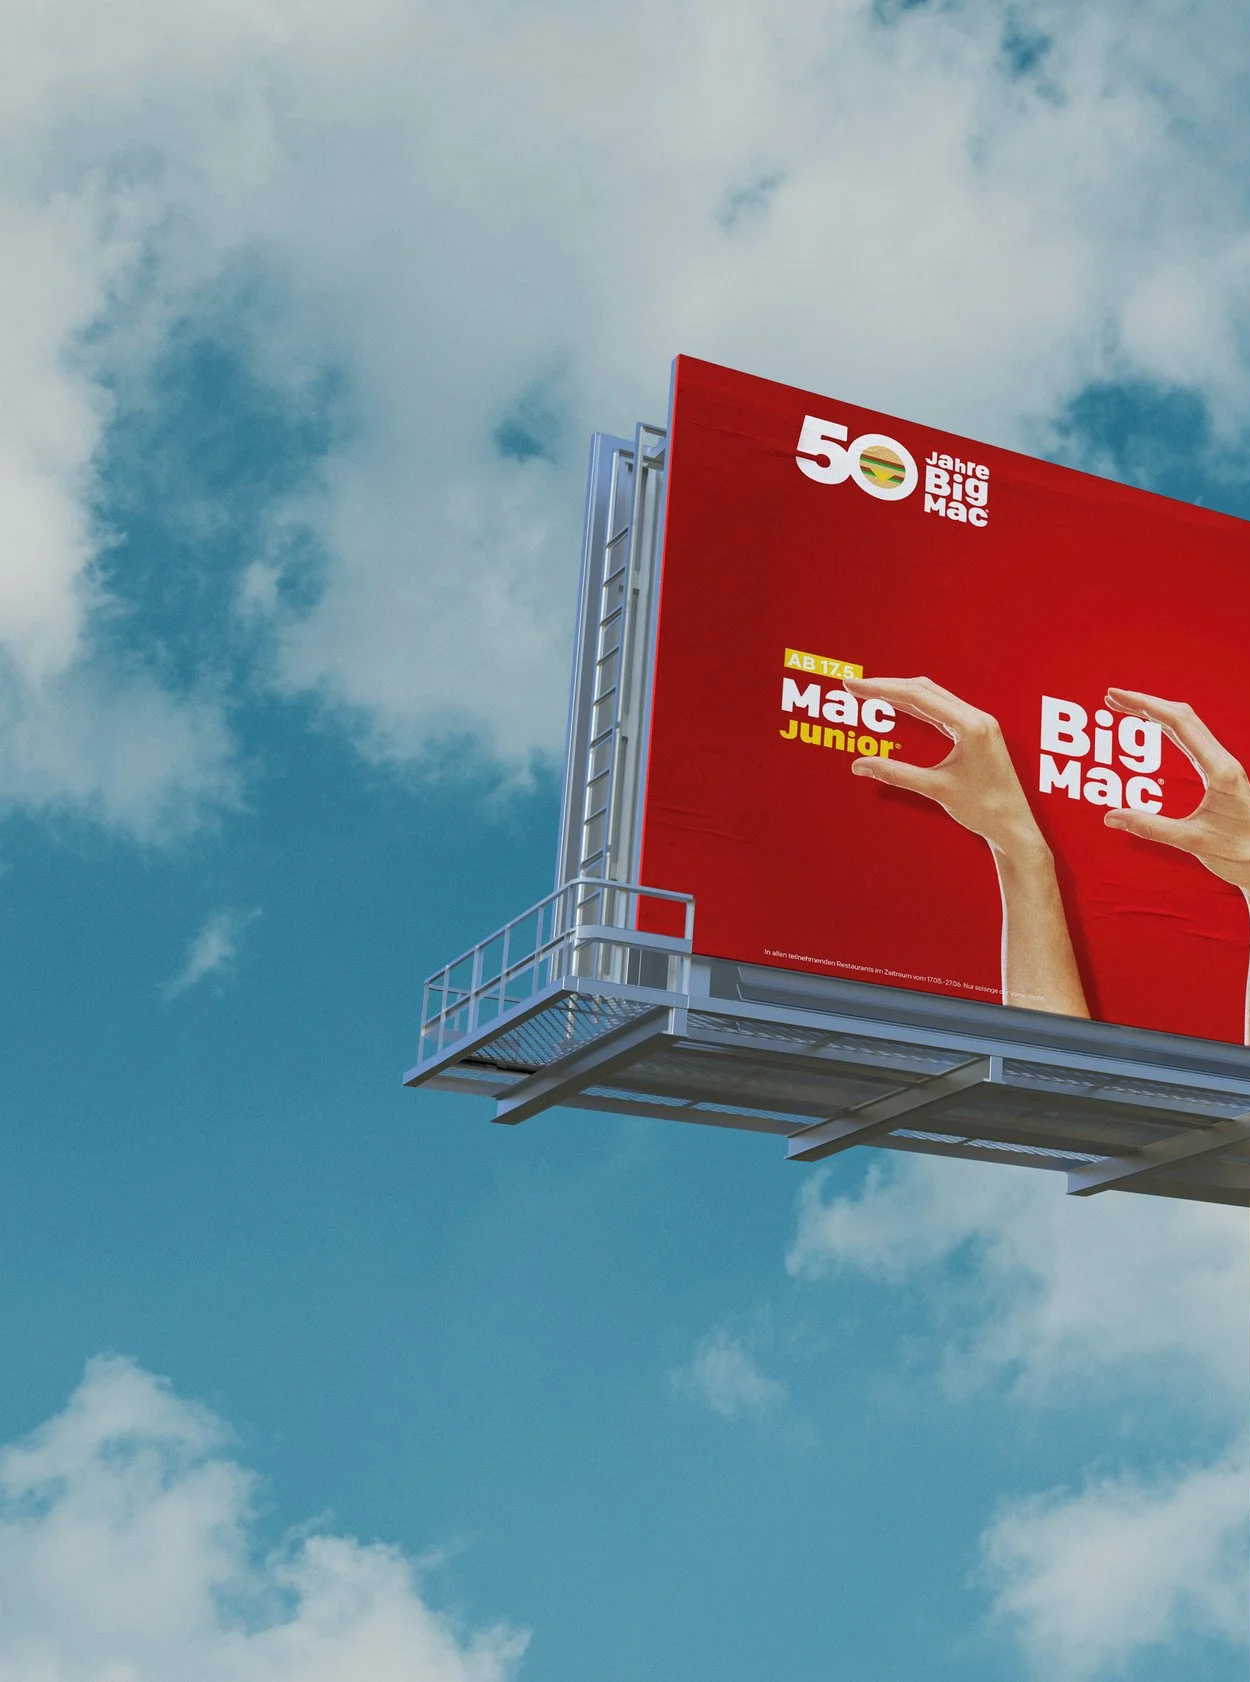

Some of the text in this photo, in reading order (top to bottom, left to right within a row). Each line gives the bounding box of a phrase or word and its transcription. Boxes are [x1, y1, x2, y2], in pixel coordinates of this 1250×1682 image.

[796, 415, 918, 501] 50
[925, 451, 990, 480] Jahre
[925, 465, 988, 507] Big
[924, 493, 989, 527] Mac
[788, 653, 816, 671] AB
[781, 677, 896, 733] Mac
[1041, 695, 1162, 774] Big
[772, 951, 787, 959] allen
[788, 953, 836, 967] teilnehmenden
[837, 961, 874, 974] Restaurants
[884, 969, 912, 979] Zeitraum
[963, 982, 974, 990] Nur
